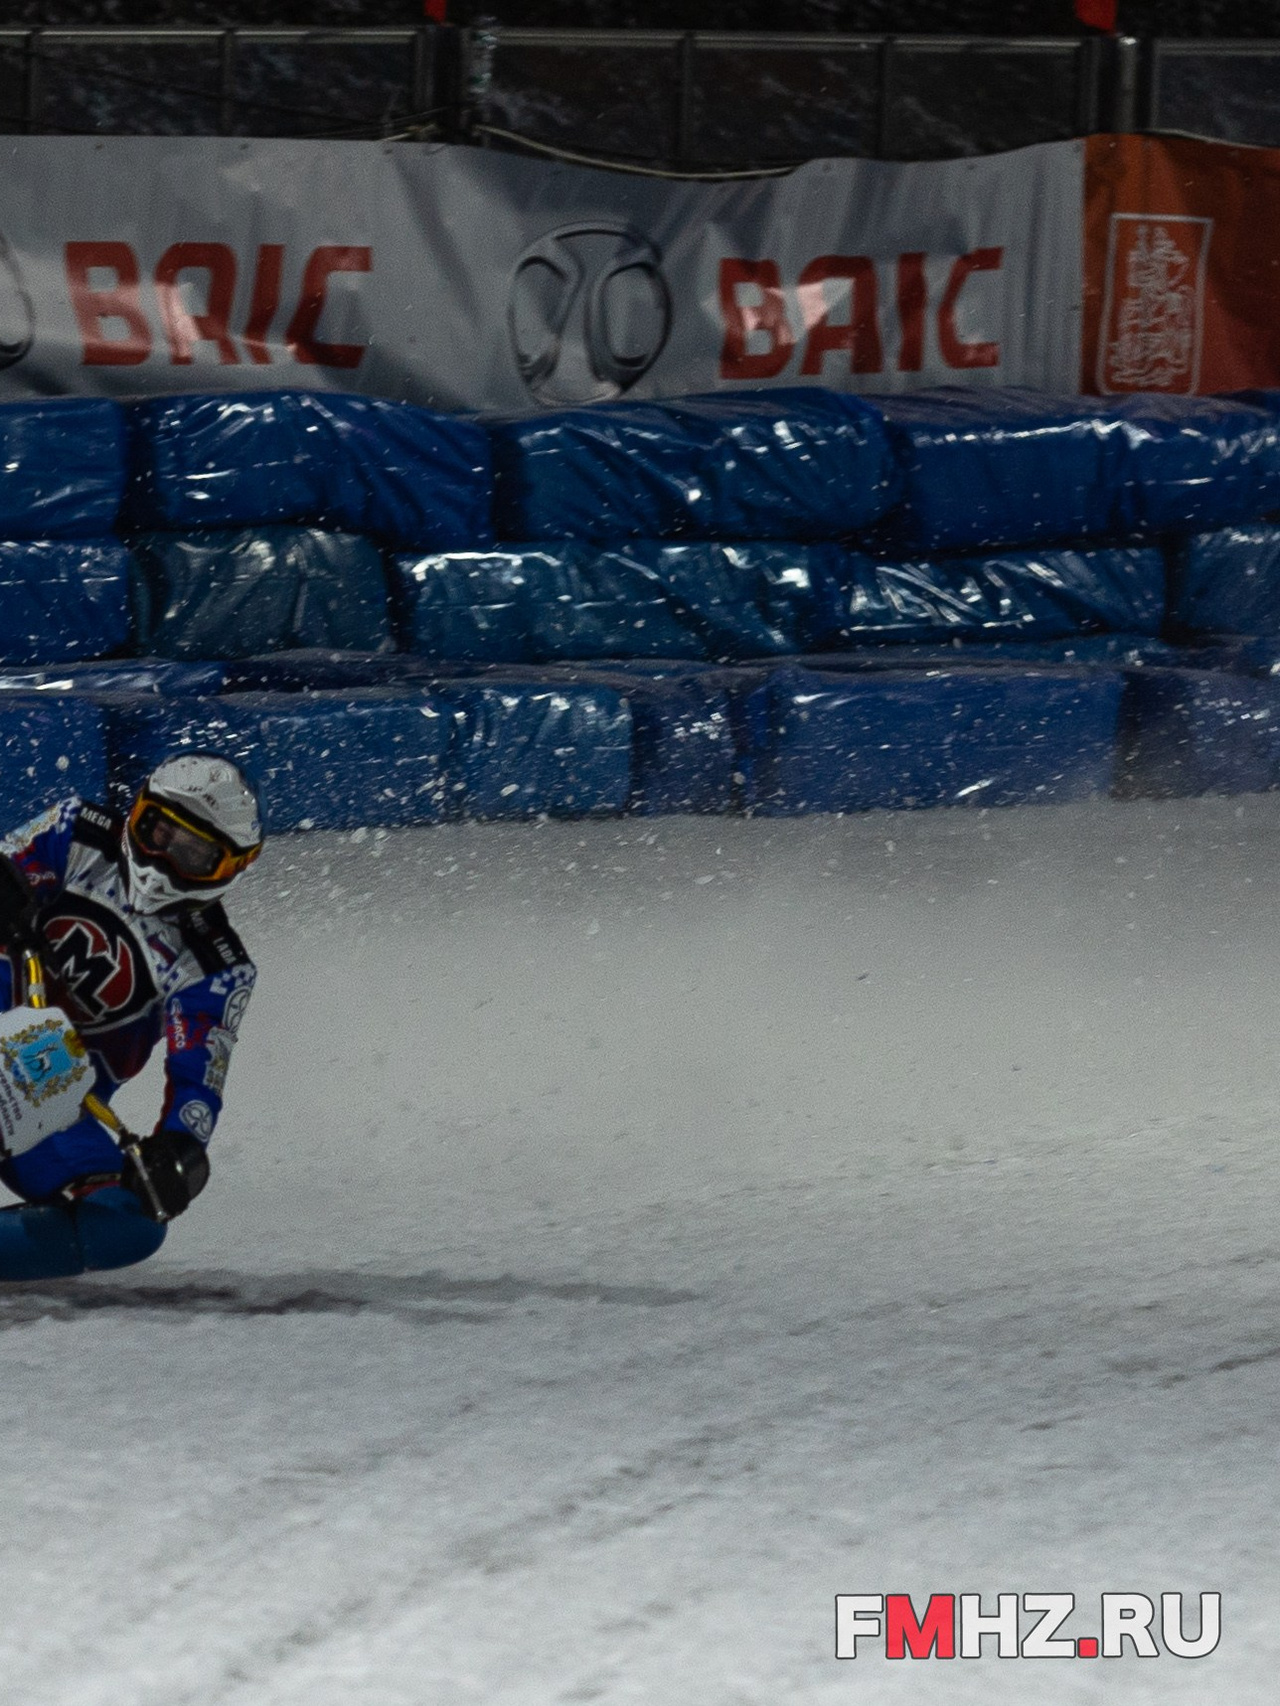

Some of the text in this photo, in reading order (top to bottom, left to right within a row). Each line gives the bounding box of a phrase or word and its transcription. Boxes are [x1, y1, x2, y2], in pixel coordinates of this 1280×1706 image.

[64, 241, 373, 368] BAIC
[720, 247, 1004, 379] BAIC
[80, 807, 112, 830] MEGA
[213, 936, 238, 965] LADA
